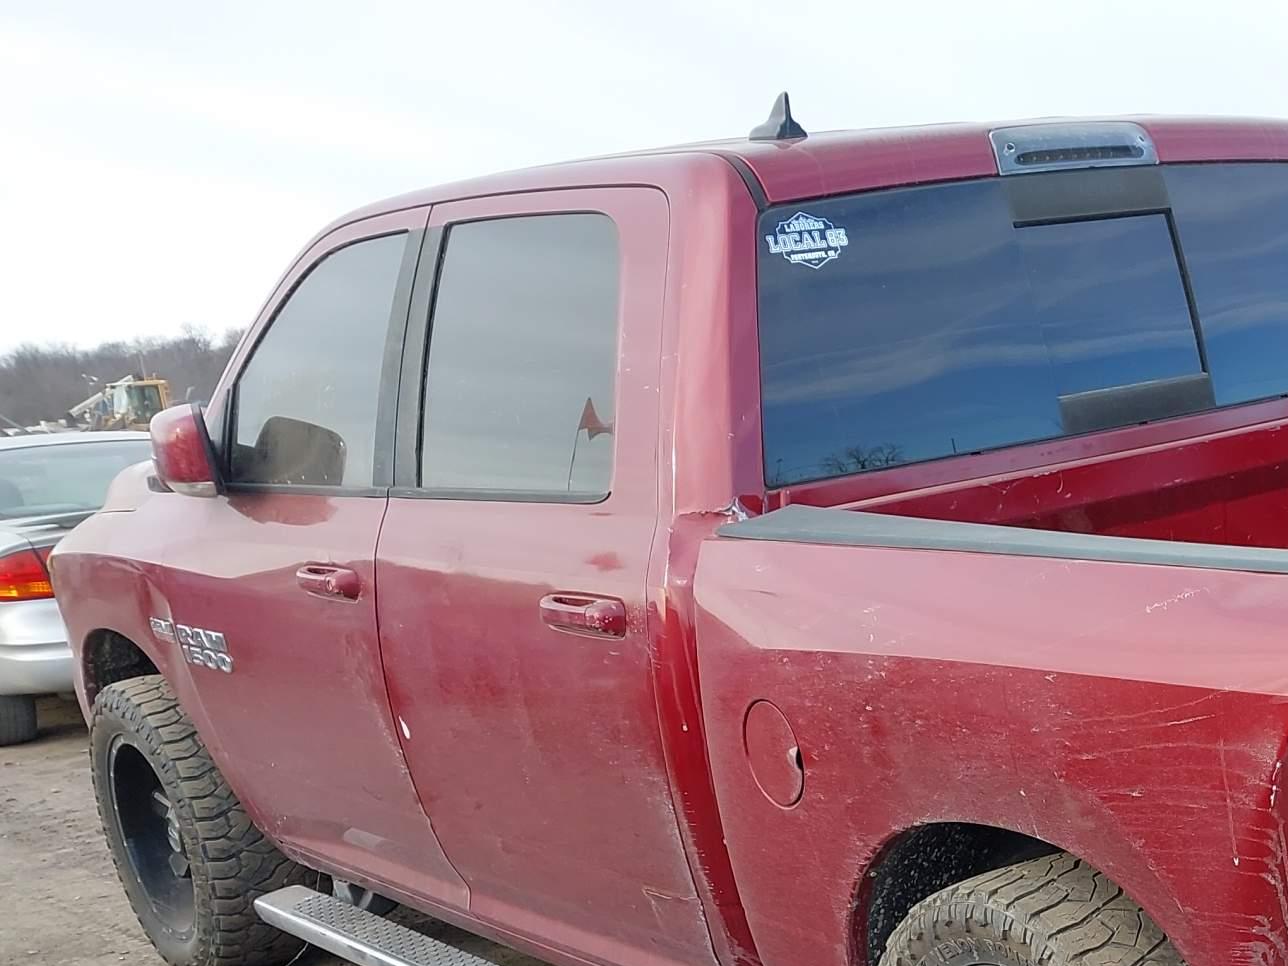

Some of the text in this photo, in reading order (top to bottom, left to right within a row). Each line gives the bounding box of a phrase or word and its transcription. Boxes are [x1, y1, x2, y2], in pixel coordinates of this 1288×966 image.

[765, 227, 849, 253] LOCAL 83
[176, 624, 227, 652] RAM
[182, 644, 234, 674] 1500
